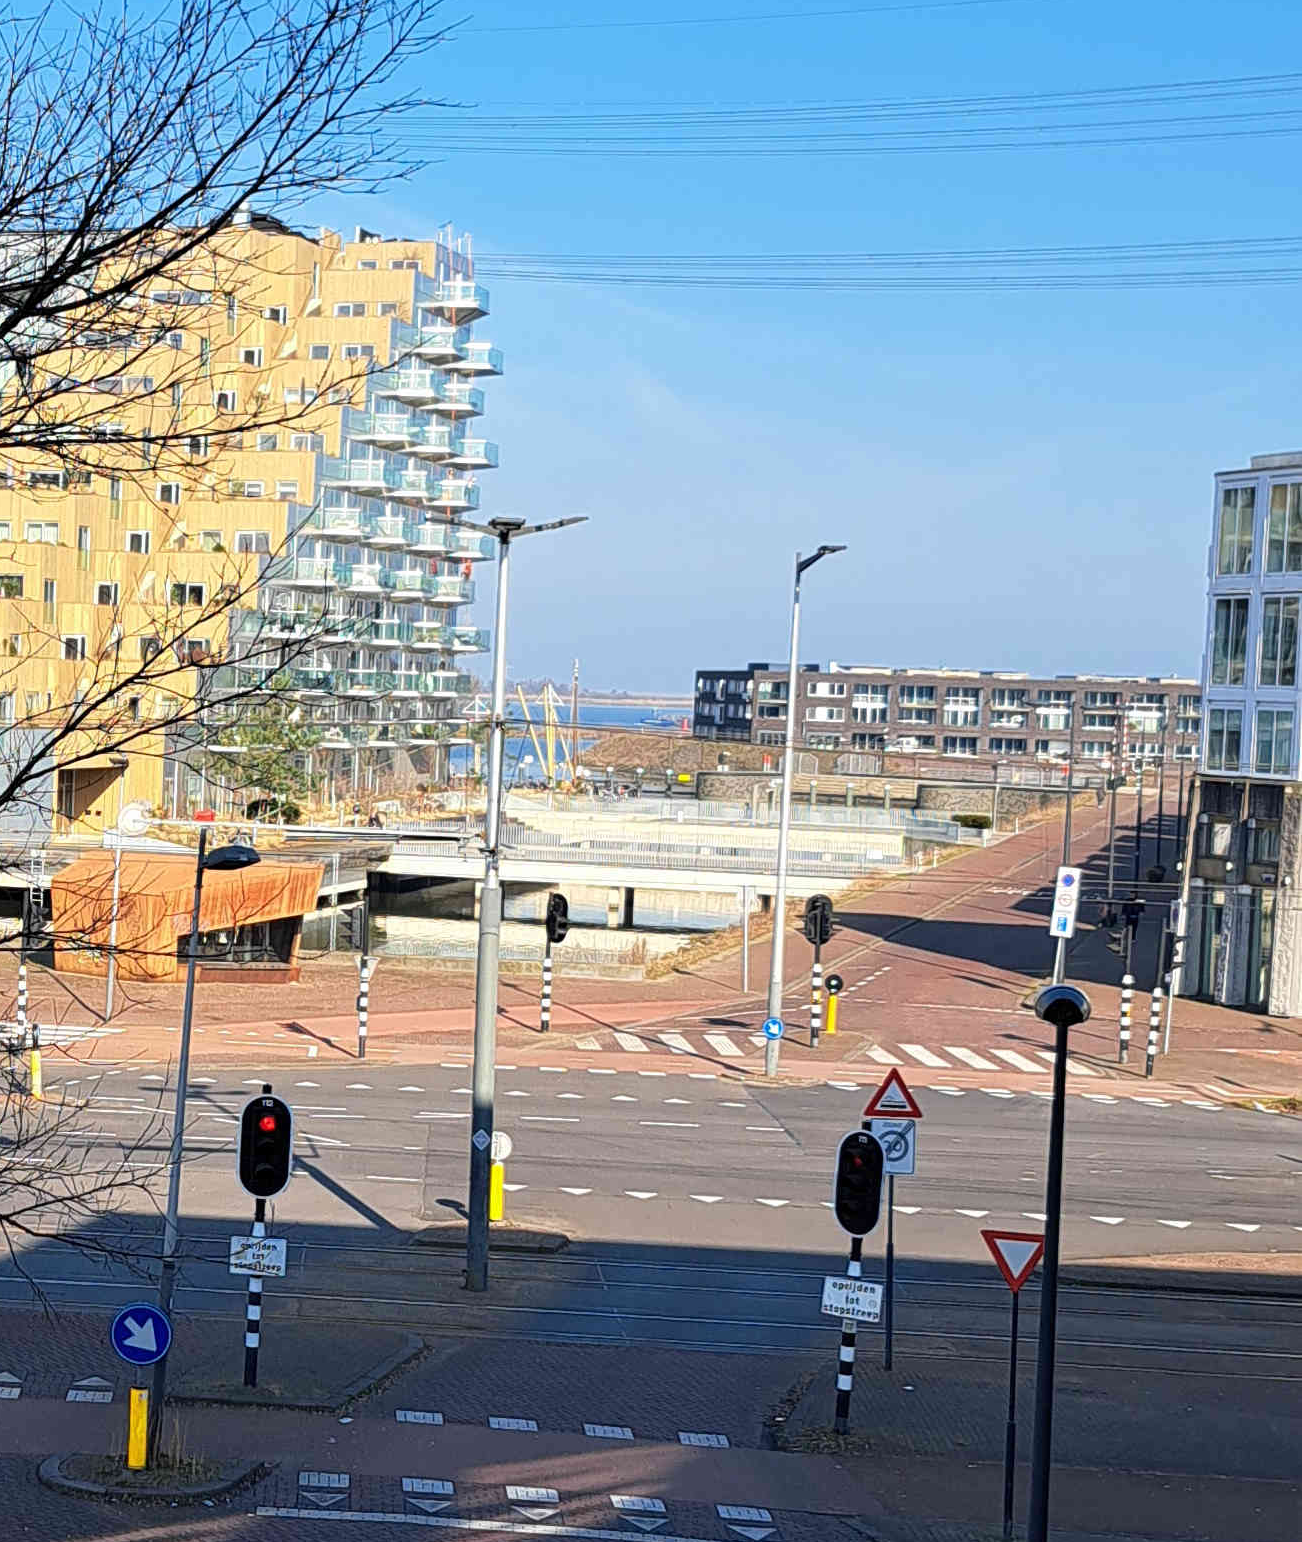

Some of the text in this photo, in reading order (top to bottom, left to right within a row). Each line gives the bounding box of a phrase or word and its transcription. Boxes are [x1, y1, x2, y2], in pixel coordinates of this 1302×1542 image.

[832, 1281, 876, 1294] oprijden
[845, 1295, 861, 1306] tot
[823, 1304, 879, 1320] stopstreep
